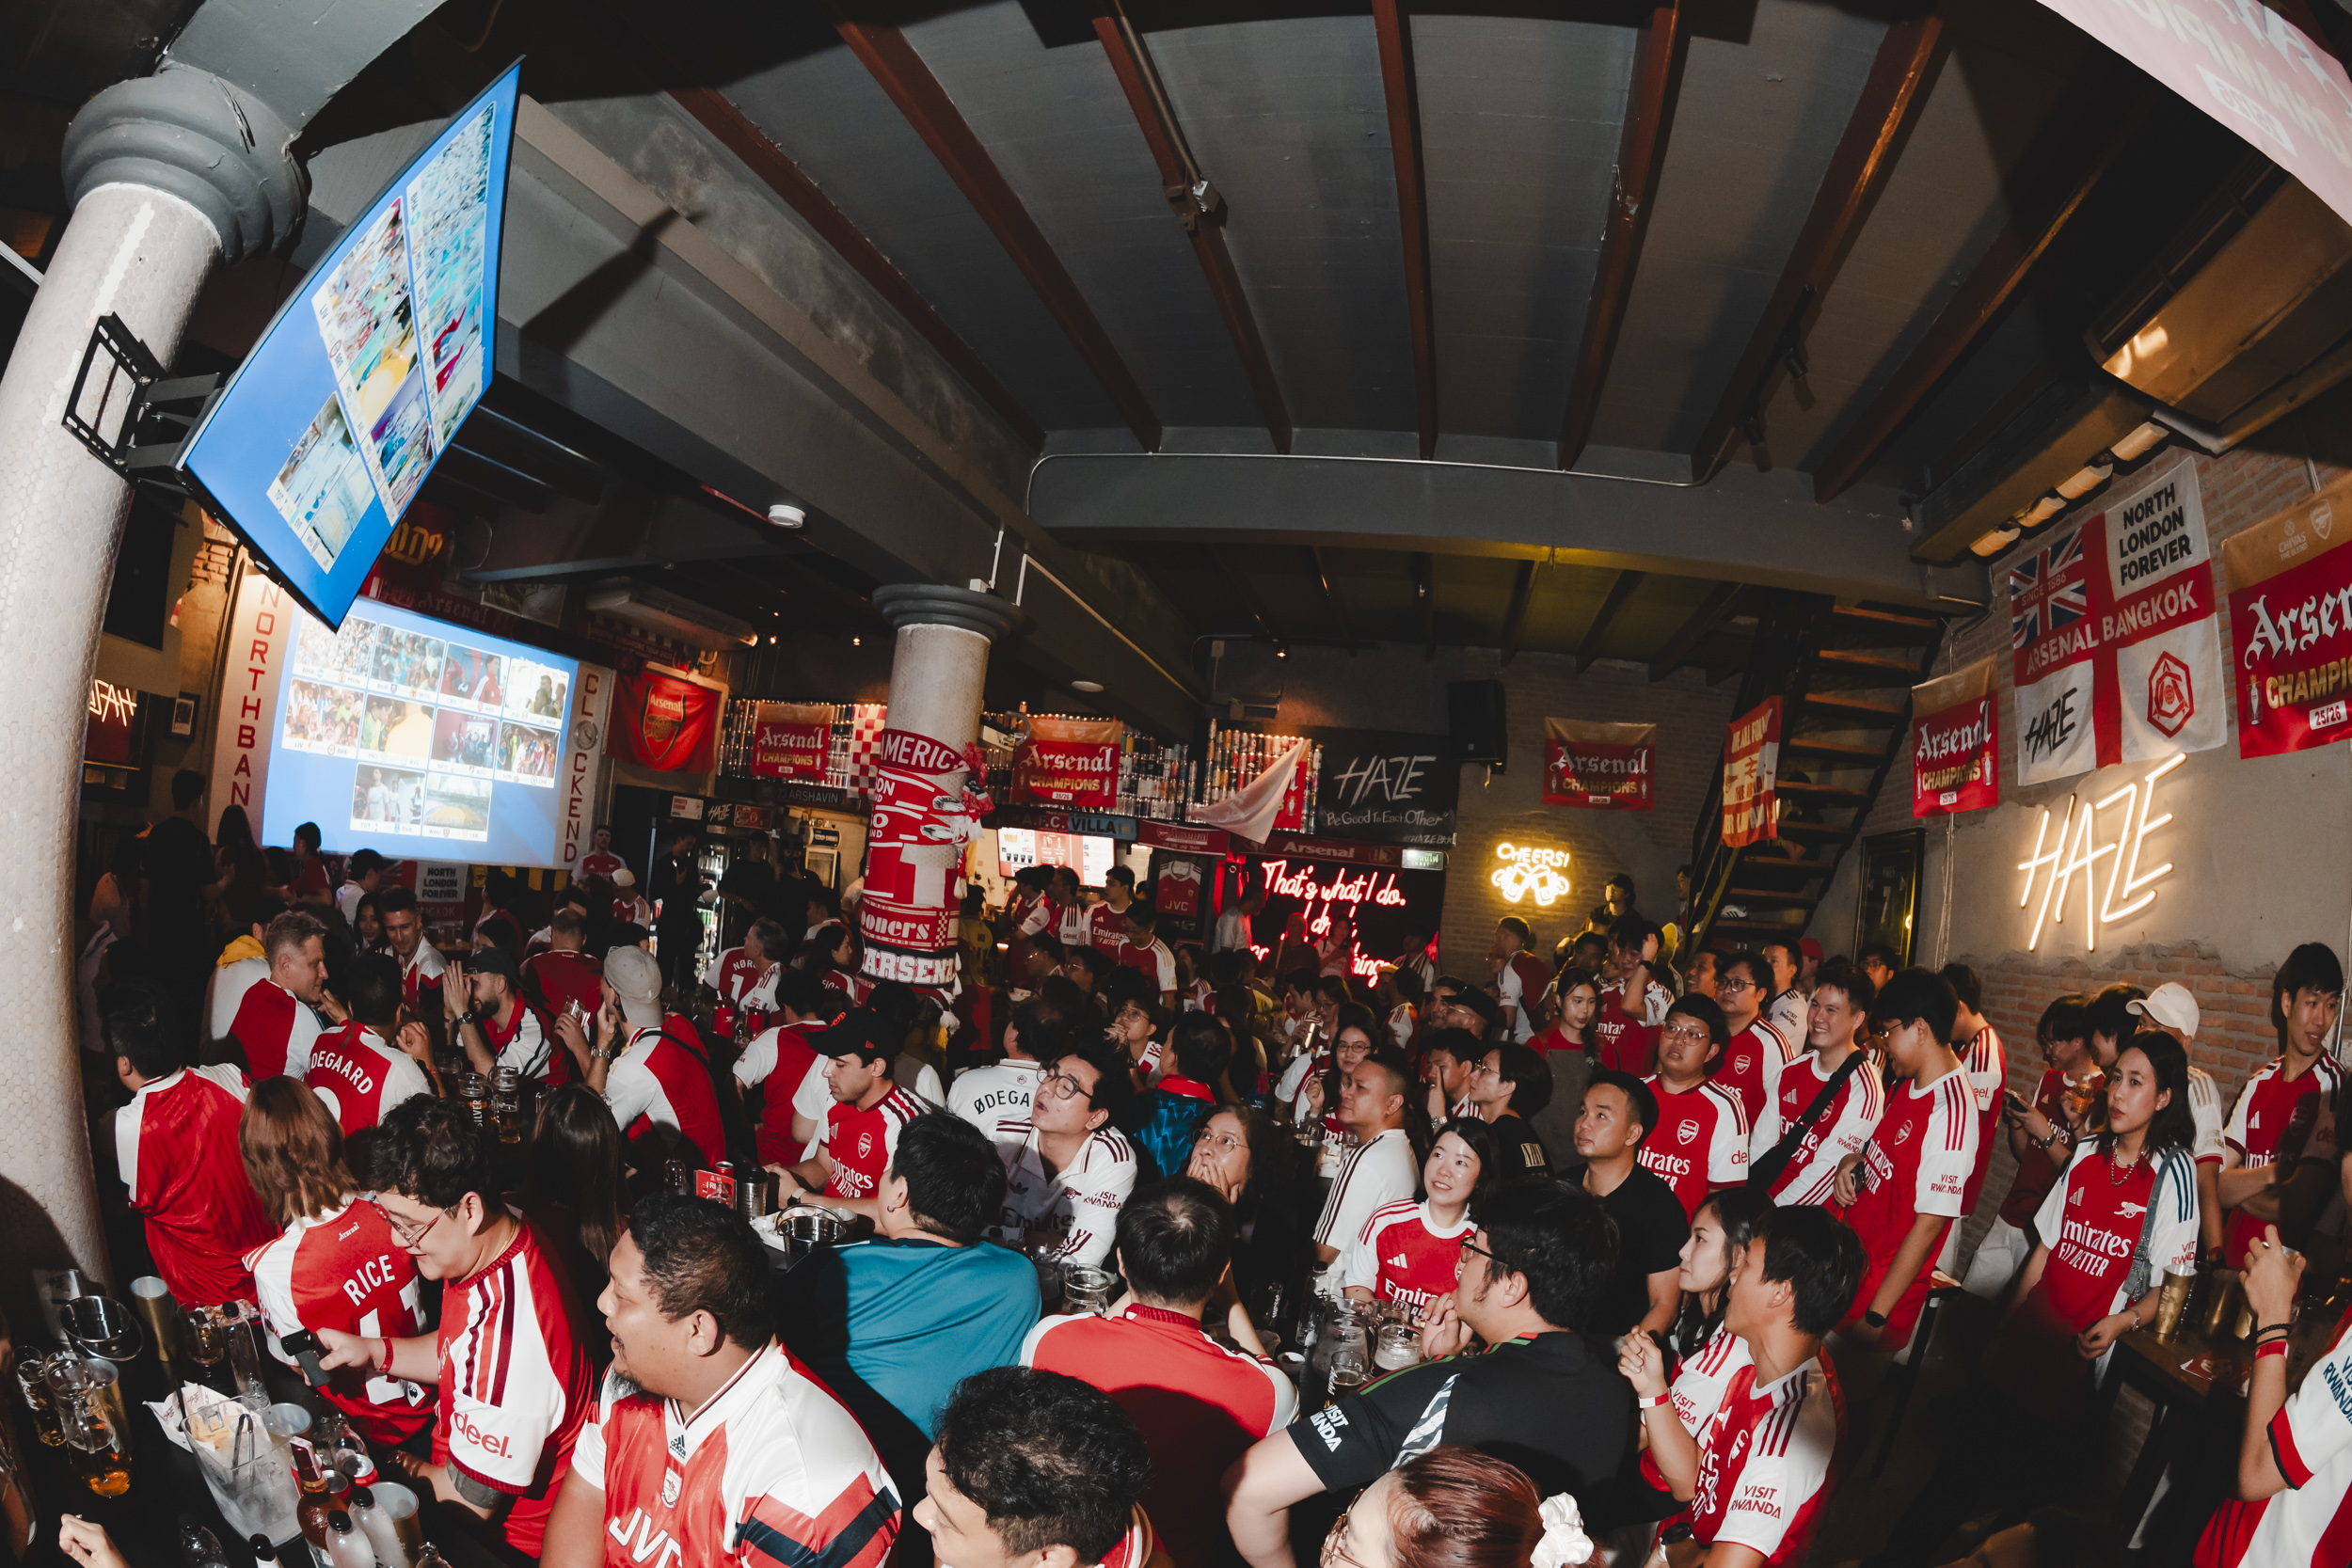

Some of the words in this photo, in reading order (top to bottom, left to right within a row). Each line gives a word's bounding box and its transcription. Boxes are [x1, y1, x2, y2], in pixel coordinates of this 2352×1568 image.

[2122, 482, 2176, 531] NORTH
[2119, 506, 2185, 560] LONDON
[2278, 531, 2307, 554] CHIVAS
[2120, 533, 2193, 587] FOREVER
[2021, 586, 2046, 607] SINCE
[2047, 572, 2068, 592] 1886
[2026, 623, 2100, 676] ARSENAL
[2102, 579, 2200, 641] BANGKOK
[649, 694, 682, 713] Arsenal
[2025, 687, 2078, 764] HAZE
[2314, 705, 2343, 727] 25/26
[755, 726, 825, 750] Arsenal
[1915, 700, 1992, 767] Arsenal
[762, 752, 813, 767] CHAMPIONS
[1019, 744, 1114, 772] Arsenal
[1549, 746, 1648, 775] Arsenal
[1028, 774, 1102, 791] CHAMPIONS
[1333, 754, 1438, 809] HAZE
[1562, 777, 1639, 794] CHAMPIONS
[1921, 758, 1981, 792] CHAMPIONS
[789, 790, 838, 803] ARSHAVIN
[707, 803, 733, 822] HAZE
[1342, 810, 1371, 825] Good
[1382, 811, 1405, 824] Each
[1071, 819, 1116, 835] VILLA
[1281, 841, 1355, 859] Arsenal
[1497, 842, 1571, 868] CHEERS!
[2017, 752, 2188, 954] HAZE
[423, 878, 458, 888] LONDON
[427, 867, 456, 877] NORTH
[1261, 860, 1319, 900] That's
[1320, 867, 1369, 903] what
[1375, 873, 1406, 906] do.
[421, 889, 458, 899] FOREVER
[1165, 900, 1188, 911] JVC
[308, 1050, 374, 1094] DEGAARD
[973, 1089, 1031, 1116] ØDEGA
[830, 1156, 874, 1190] mirates
[1940, 1173, 1959, 1184] VISIT
[338, 1222, 360, 1243] Arsenal
[342, 1254, 396, 1307] RICE
[1673, 1388, 1696, 1411] VISIT
[453, 1412, 513, 1459] deel.
[1743, 1484, 1778, 1500] VISIT
[1729, 1498, 1782, 1520] RWANDA
